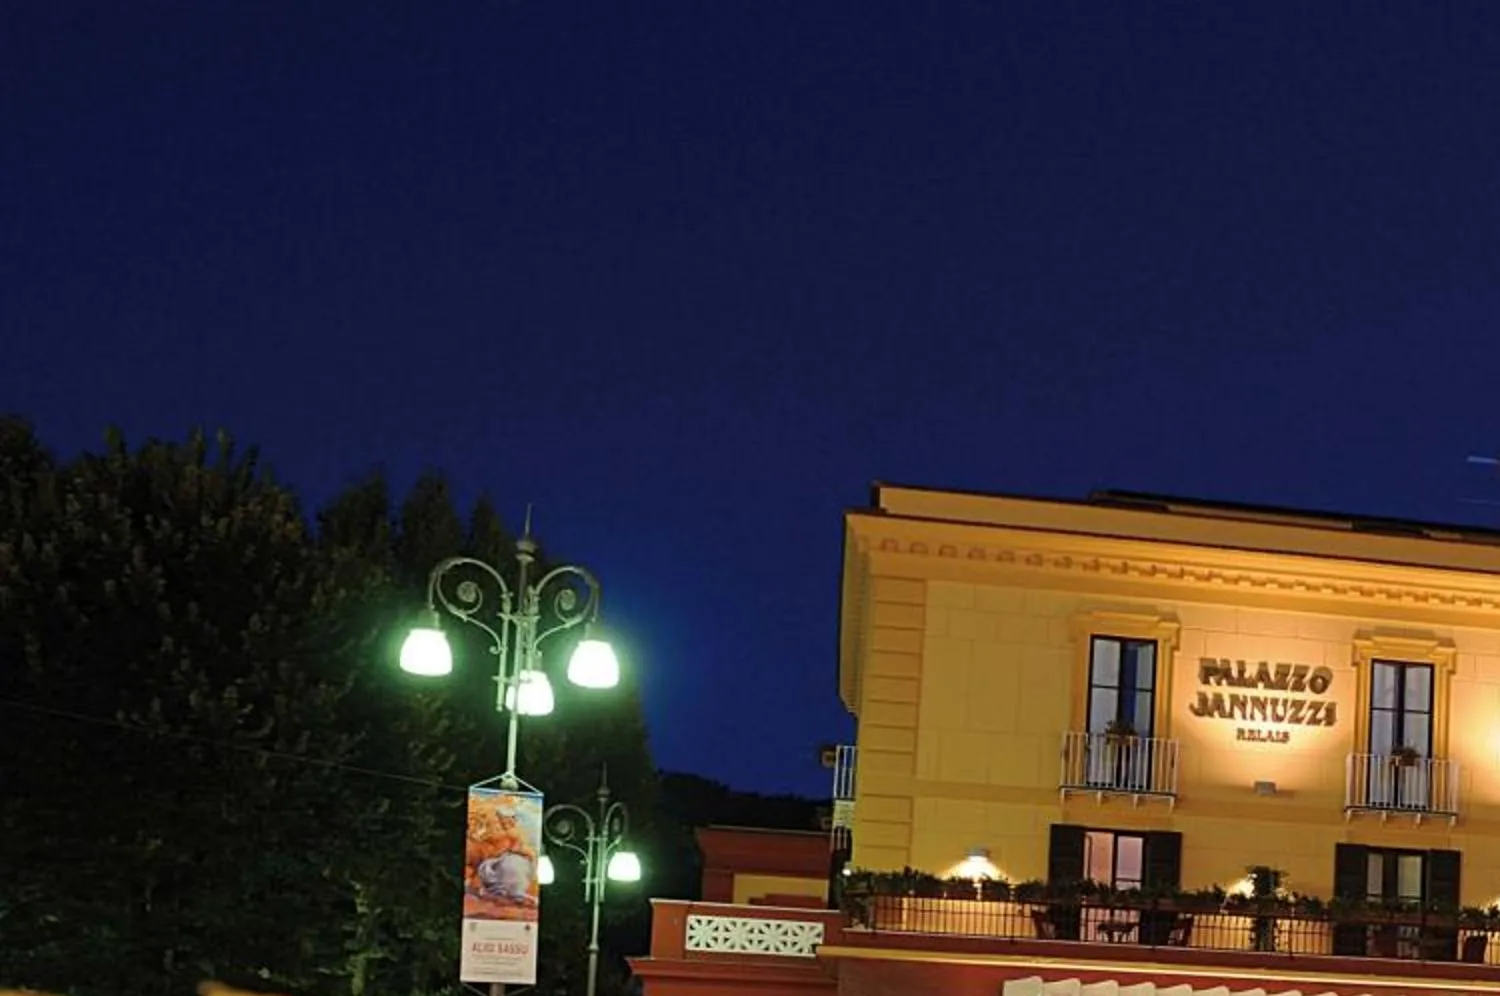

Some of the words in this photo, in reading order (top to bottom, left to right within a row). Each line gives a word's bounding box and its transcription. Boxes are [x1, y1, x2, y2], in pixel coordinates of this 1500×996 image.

[1199, 656, 1333, 694] PALAZZO
[1189, 691, 1338, 727] JANNUZZI
[1236, 727, 1290, 744] RELAIS
